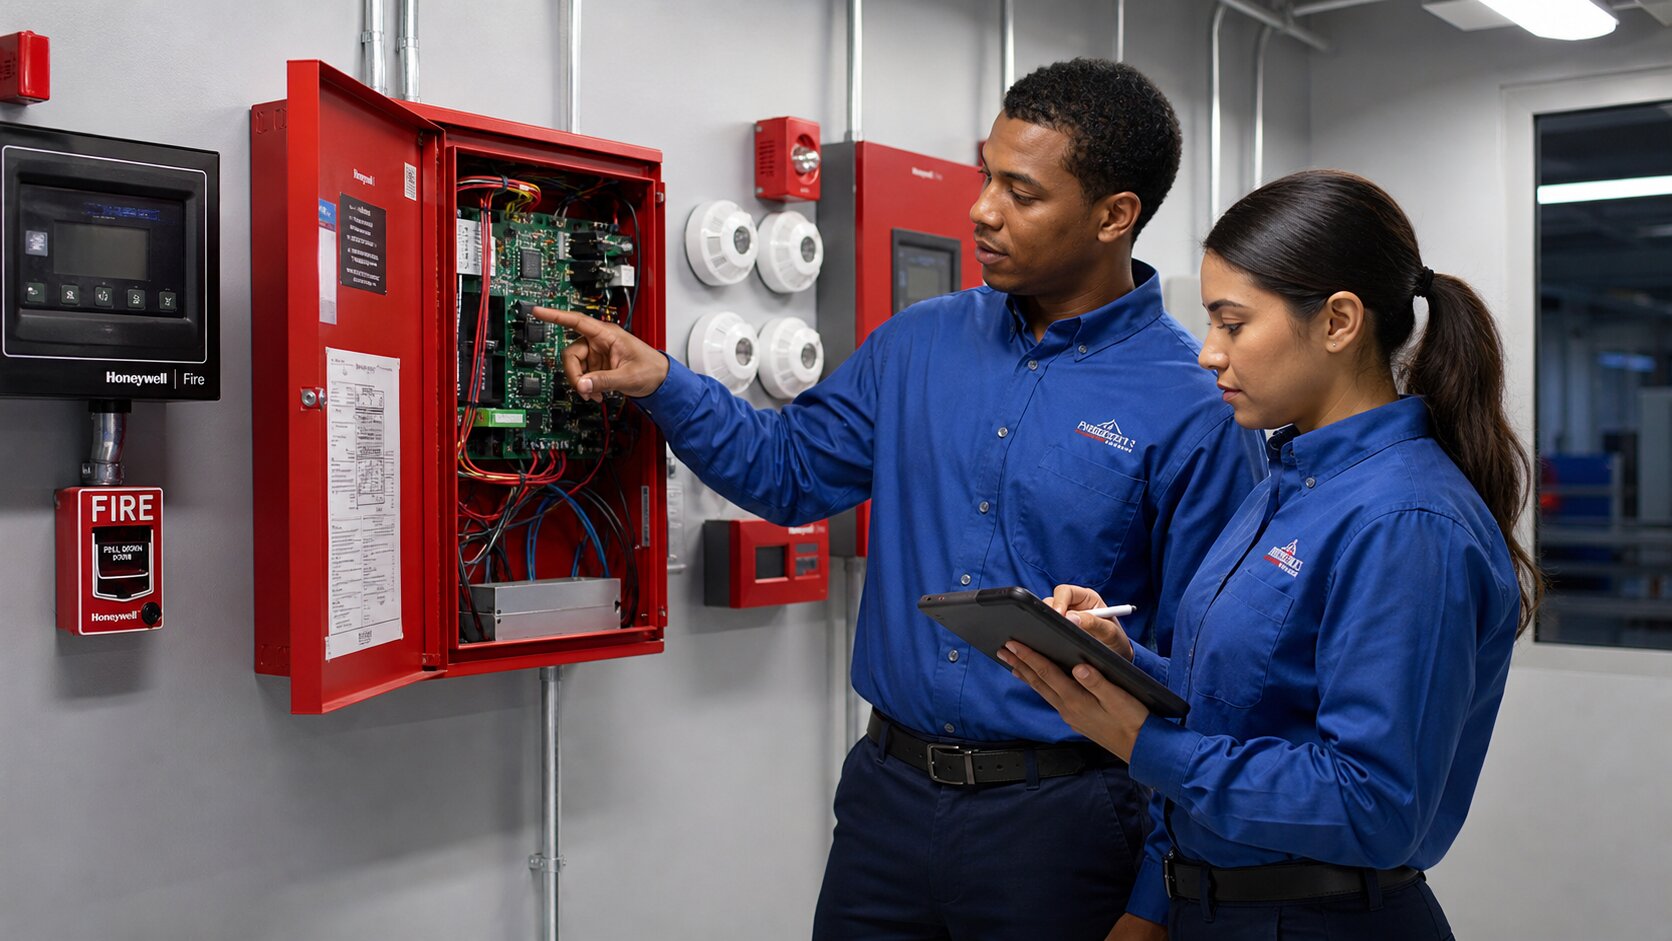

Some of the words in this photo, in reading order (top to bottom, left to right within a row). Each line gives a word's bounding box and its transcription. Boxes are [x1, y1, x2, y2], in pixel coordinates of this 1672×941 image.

[106, 371, 167, 386] Honeywell
[183, 372, 205, 385] Fire
[92, 495, 154, 522] FIRE
[91, 610, 137, 622] Honeywell
